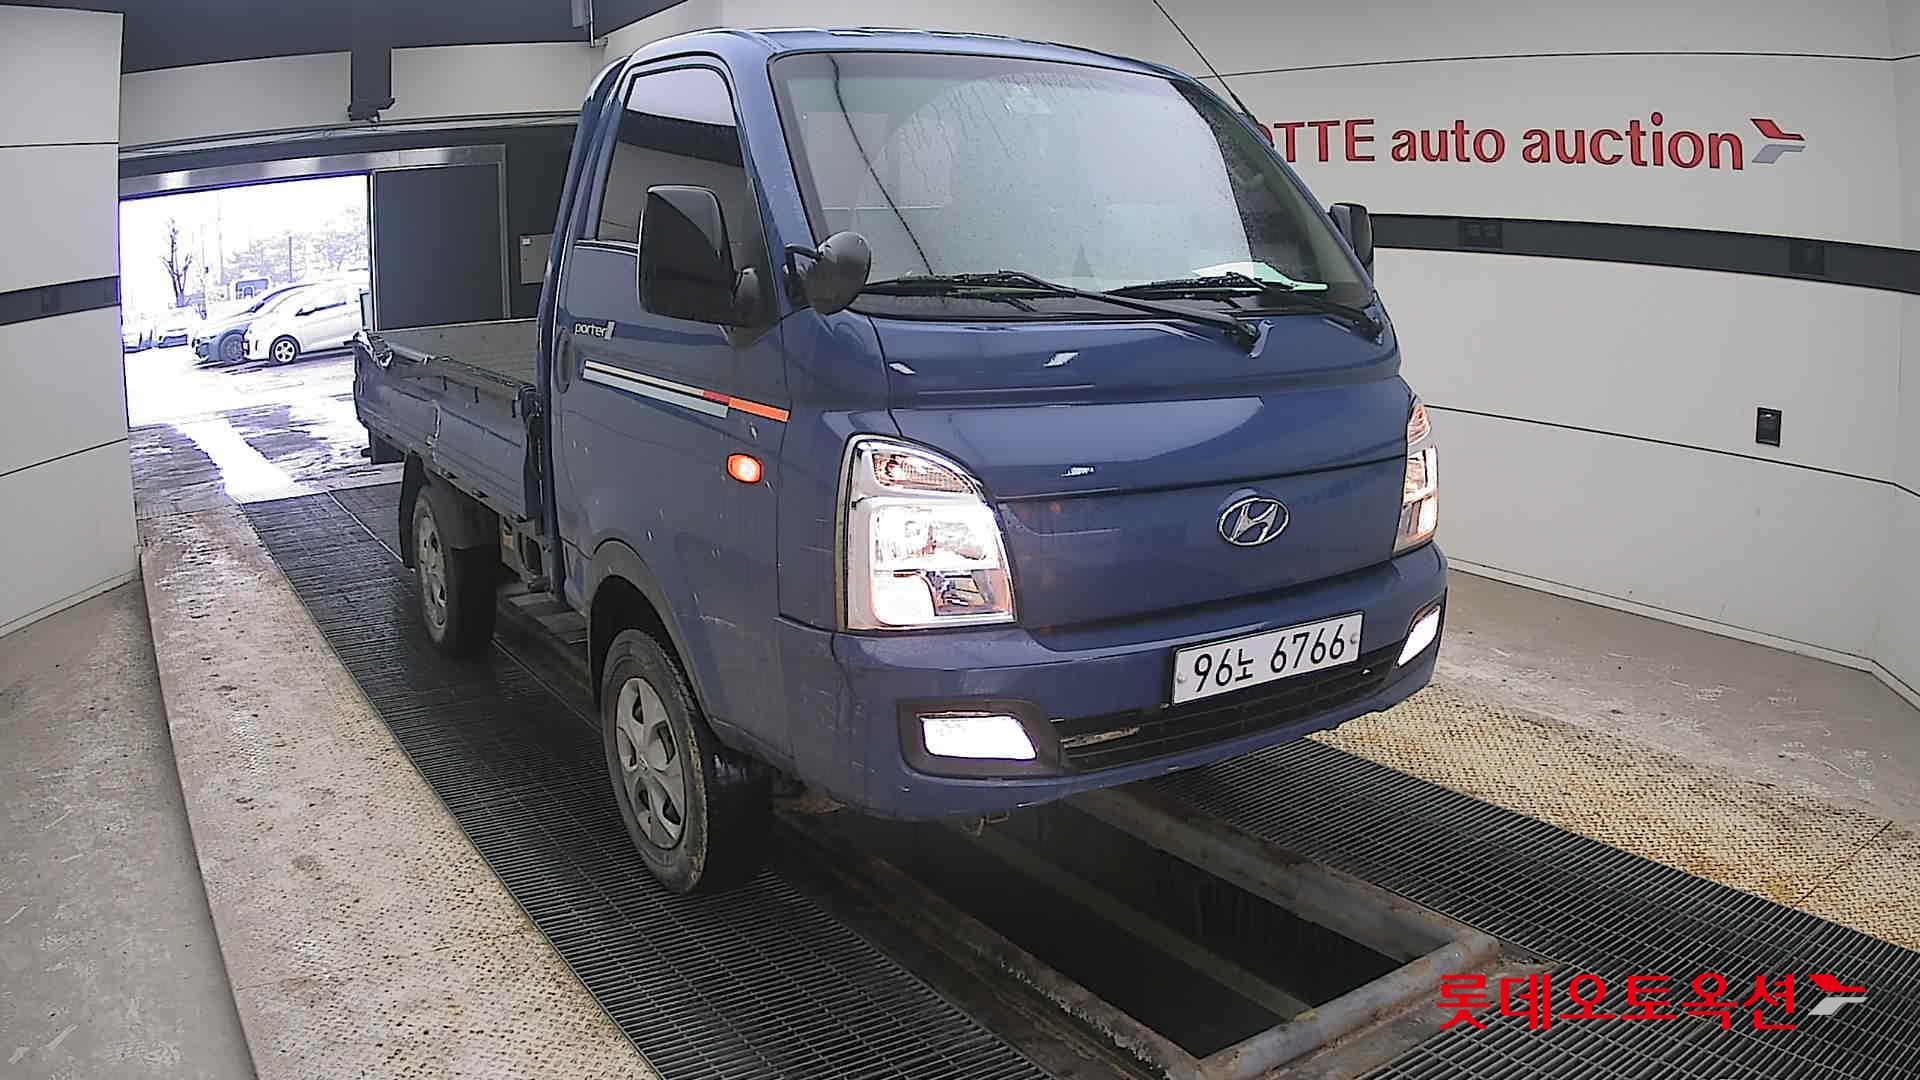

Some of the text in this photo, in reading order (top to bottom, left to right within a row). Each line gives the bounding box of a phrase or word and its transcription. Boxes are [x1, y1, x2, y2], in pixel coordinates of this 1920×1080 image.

[1258, 112, 1744, 171] TTE auto auction
[1194, 624, 1345, 693] 96노 6766
